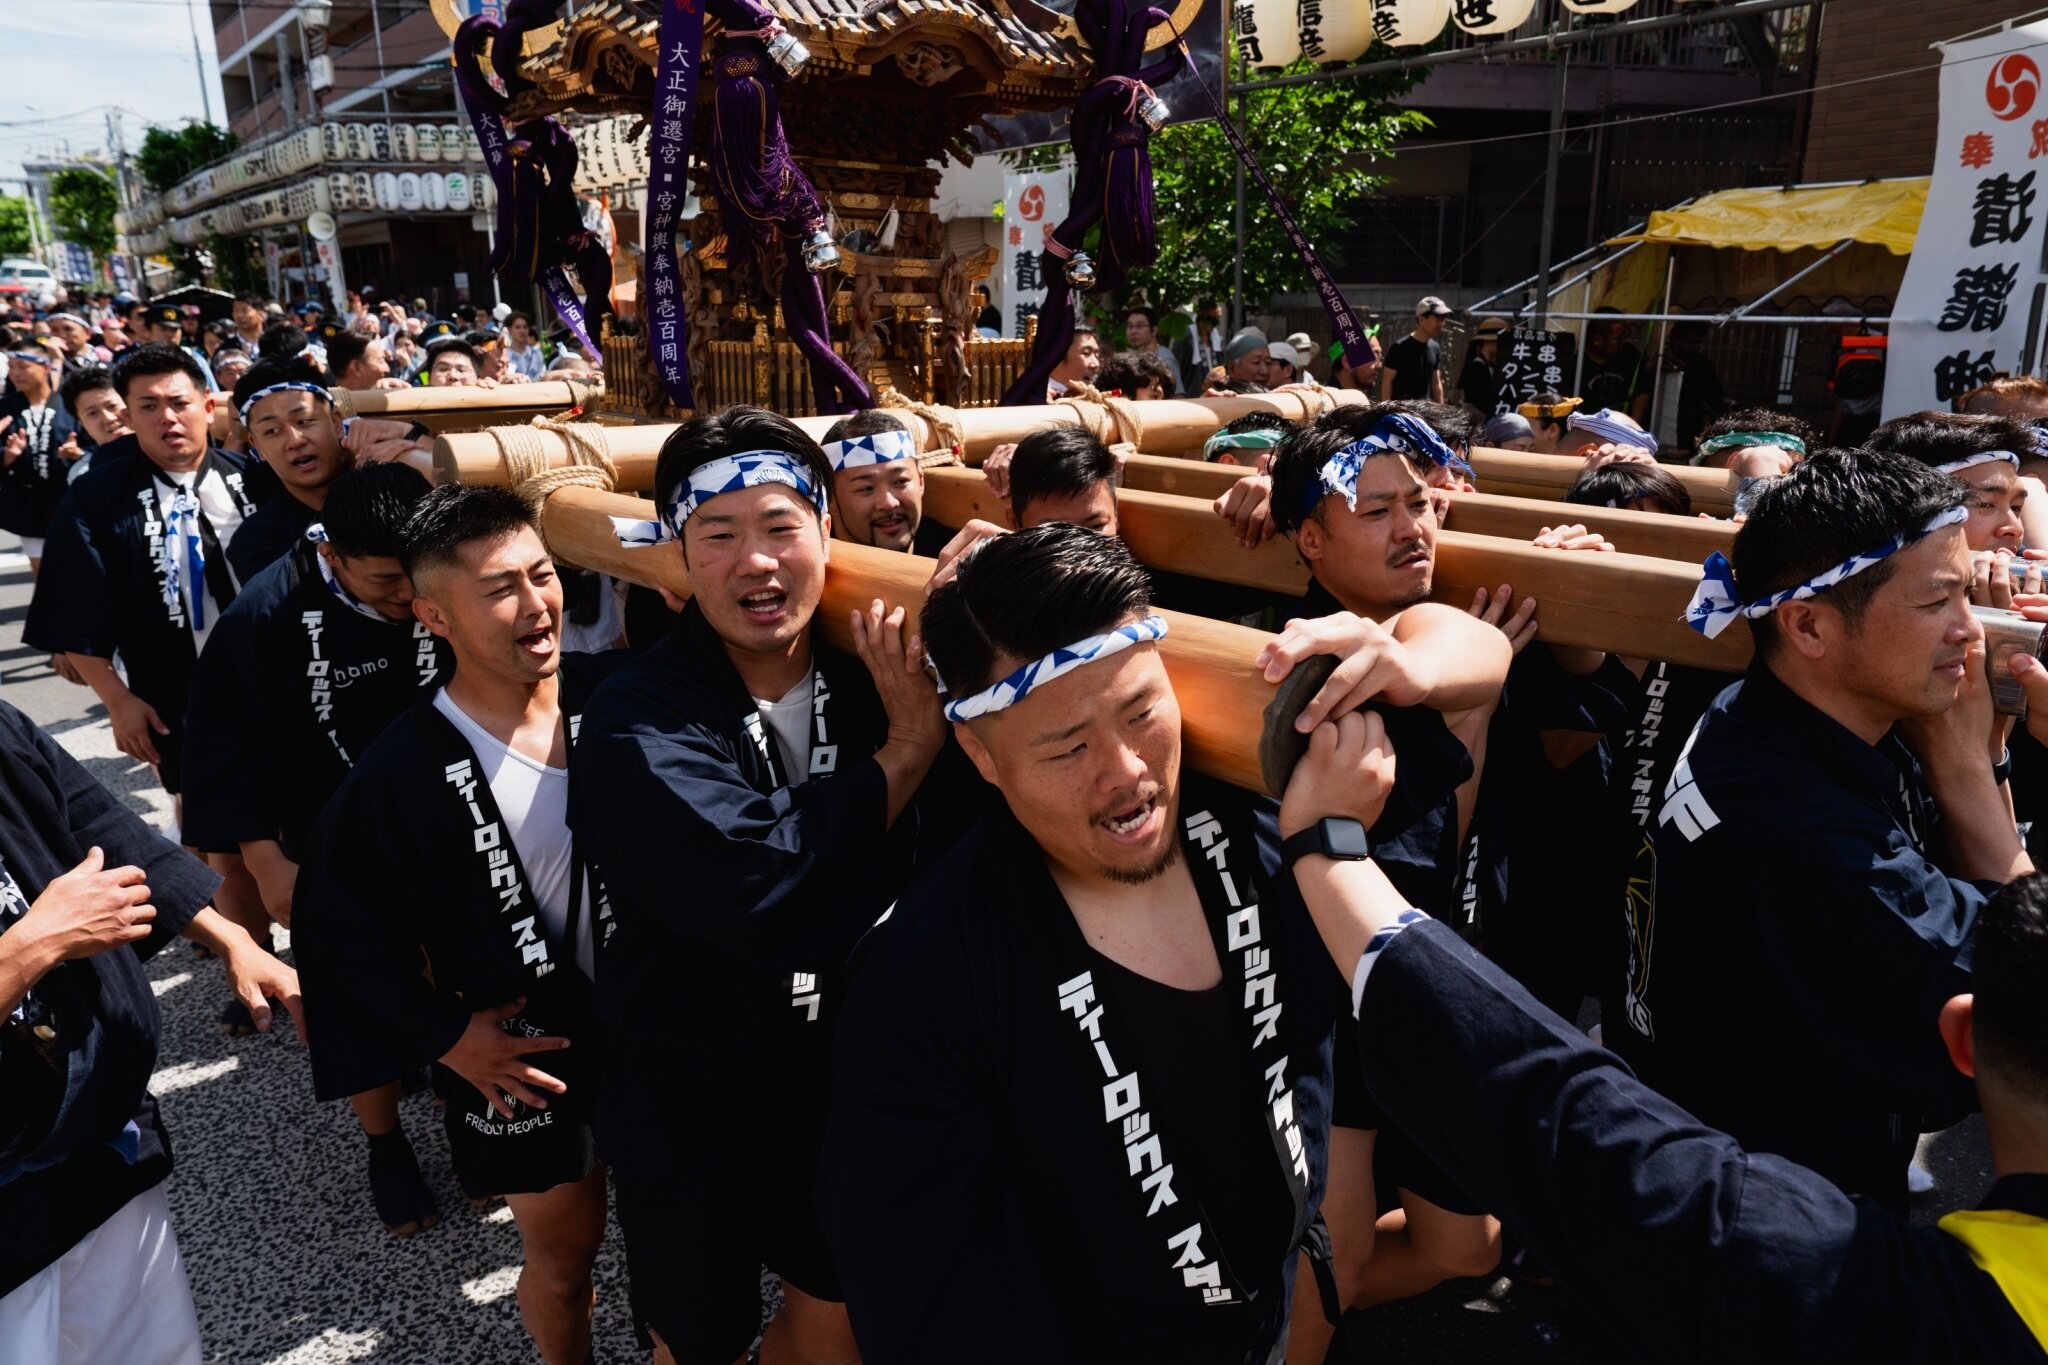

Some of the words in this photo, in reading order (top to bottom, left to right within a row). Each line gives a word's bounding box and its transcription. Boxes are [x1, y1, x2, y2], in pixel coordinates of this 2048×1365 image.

[1502, 363, 1562, 384] タン串
[301, 610, 334, 723] ティーロックス
[445, 758, 523, 914] ティーロックス
[1630, 759, 1656, 828] スタッフ
[1185, 809, 1284, 1050] ティーロックス
[507, 1111, 553, 1136] PEOPLE
[1057, 970, 1179, 1218] ティーロックス
